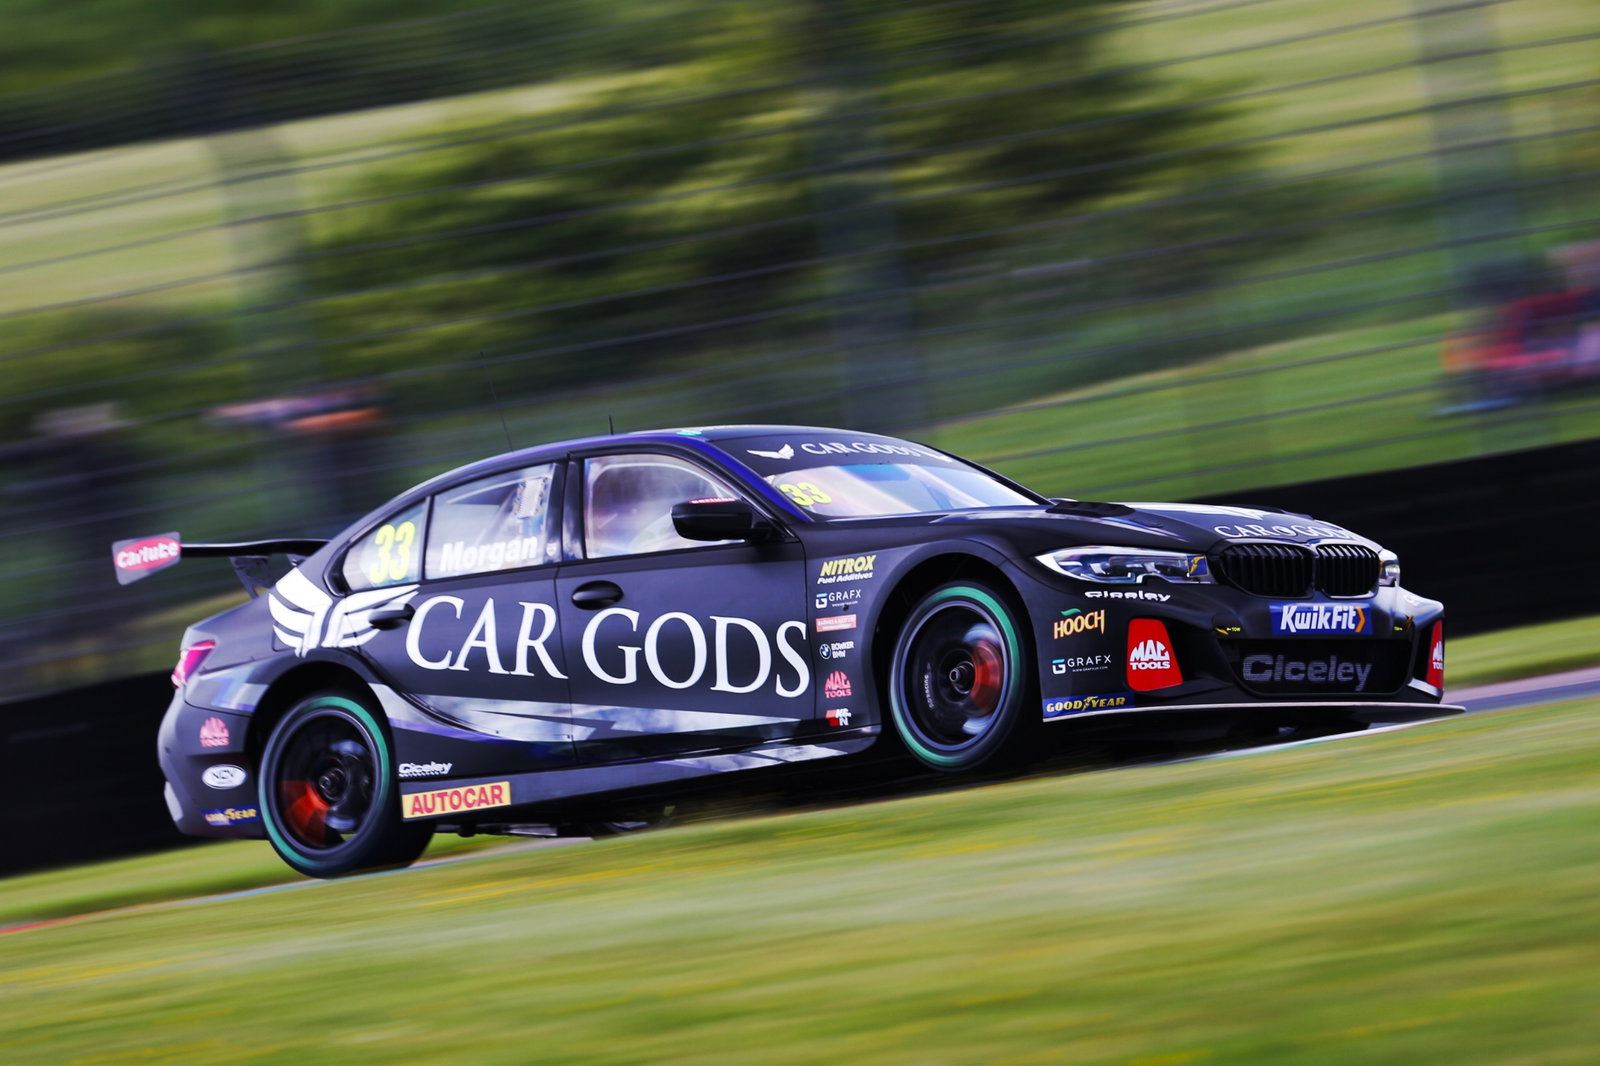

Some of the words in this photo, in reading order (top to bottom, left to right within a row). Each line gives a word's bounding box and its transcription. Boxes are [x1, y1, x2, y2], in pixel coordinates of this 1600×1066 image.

[801, 443, 858, 455] CAR
[780, 482, 832, 506] 33
[1214, 524, 1280, 538] CAR
[369, 521, 416, 584] 33
[440, 536, 538, 572] Morgan
[820, 555, 877, 577] NITROX
[817, 576, 836, 585] Fuel
[836, 572, 873, 583] Additives
[828, 589, 862, 602] GRAFX
[1053, 609, 1105, 640] HOOCH
[405, 595, 568, 680] CAR
[581, 607, 811, 698] GODS
[1130, 639, 1170, 662] MAC
[1067, 655, 1111, 667] GRAFX
[1130, 662, 1171, 670] TOOLS
[825, 671, 851, 691] MAC
[825, 689, 852, 698] TOOLS
[411, 785, 503, 815] AUTOCAR
